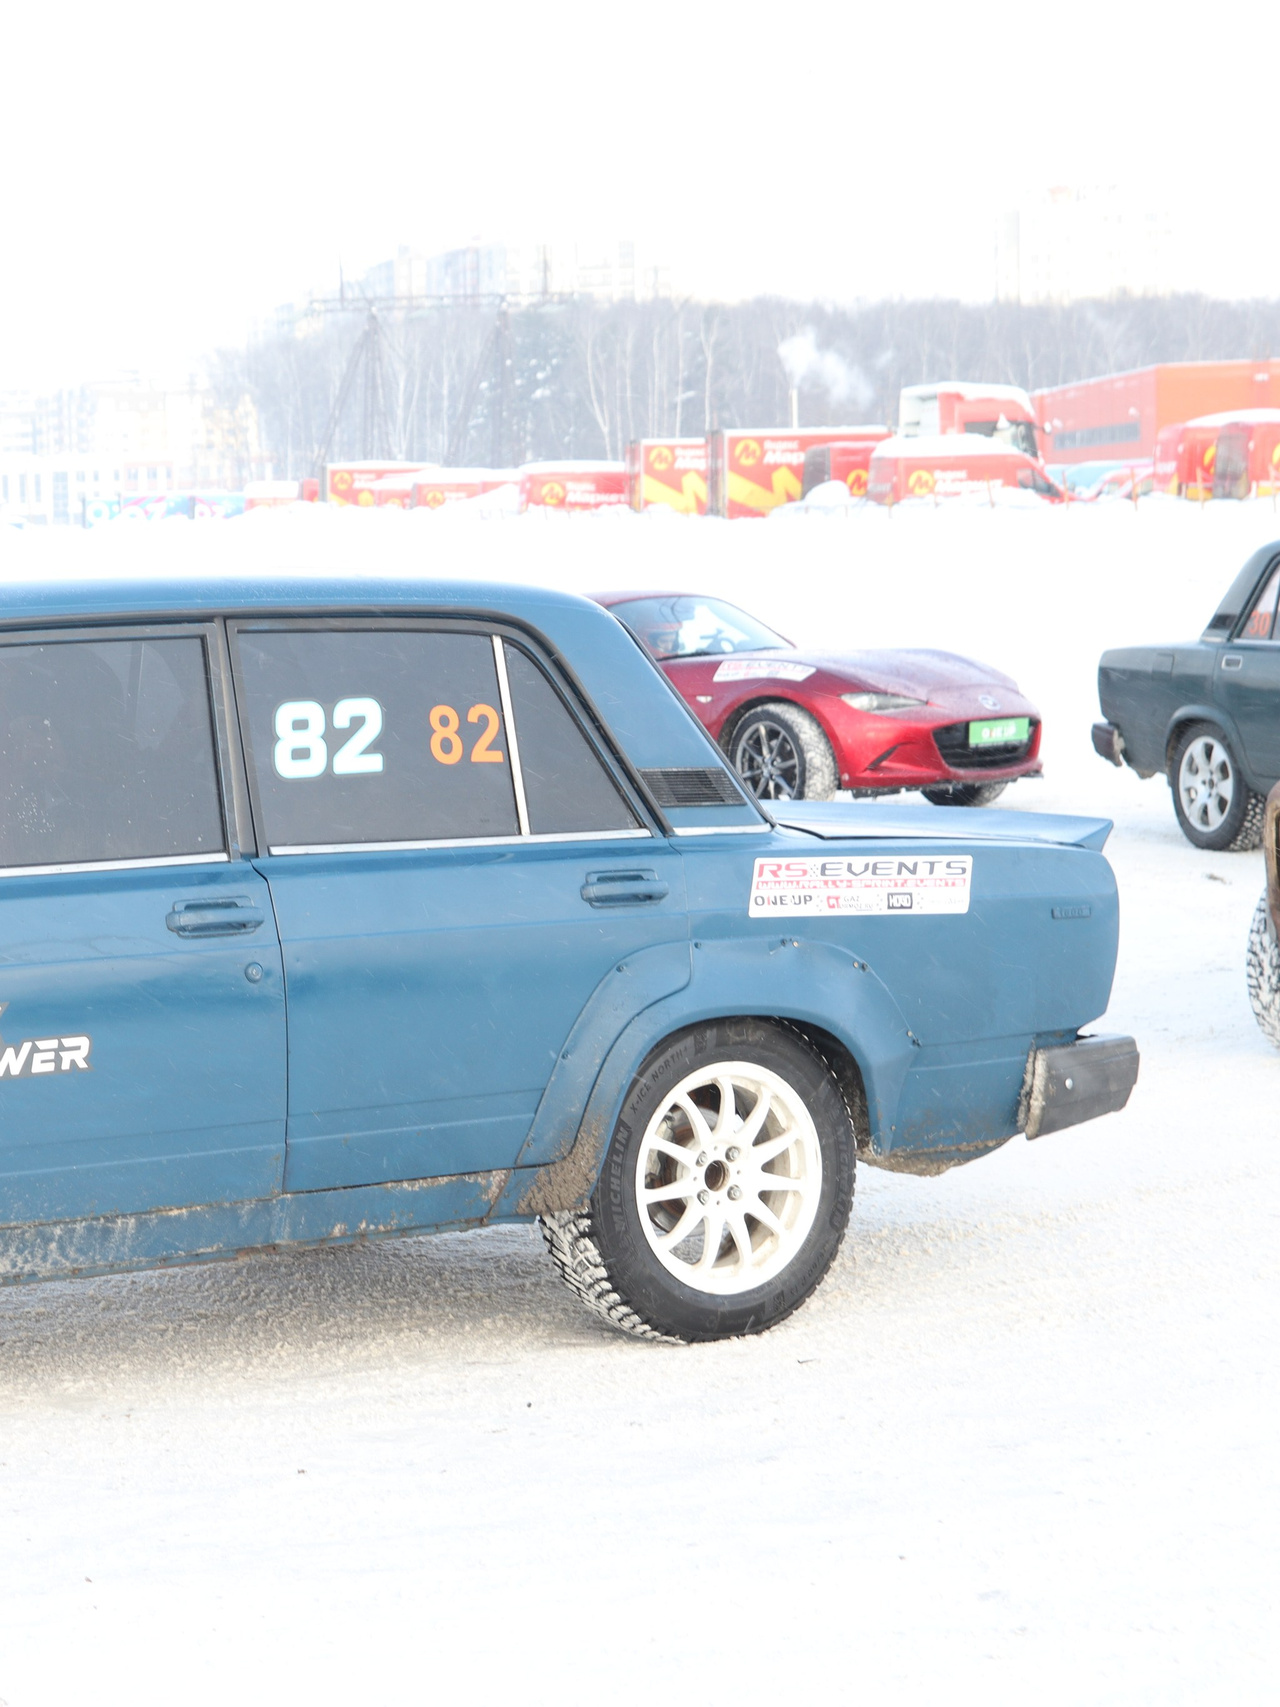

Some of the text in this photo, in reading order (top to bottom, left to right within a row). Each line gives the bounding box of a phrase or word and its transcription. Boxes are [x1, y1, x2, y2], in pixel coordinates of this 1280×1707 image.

[764, 451, 804, 464] Мар
[1249, 609, 1270, 636] 30
[274, 697, 384, 779] 82
[429, 703, 504, 765] 82
[757, 860, 967, 878] RS EVENTS
[609, 1125, 631, 1233] MICHELIN
